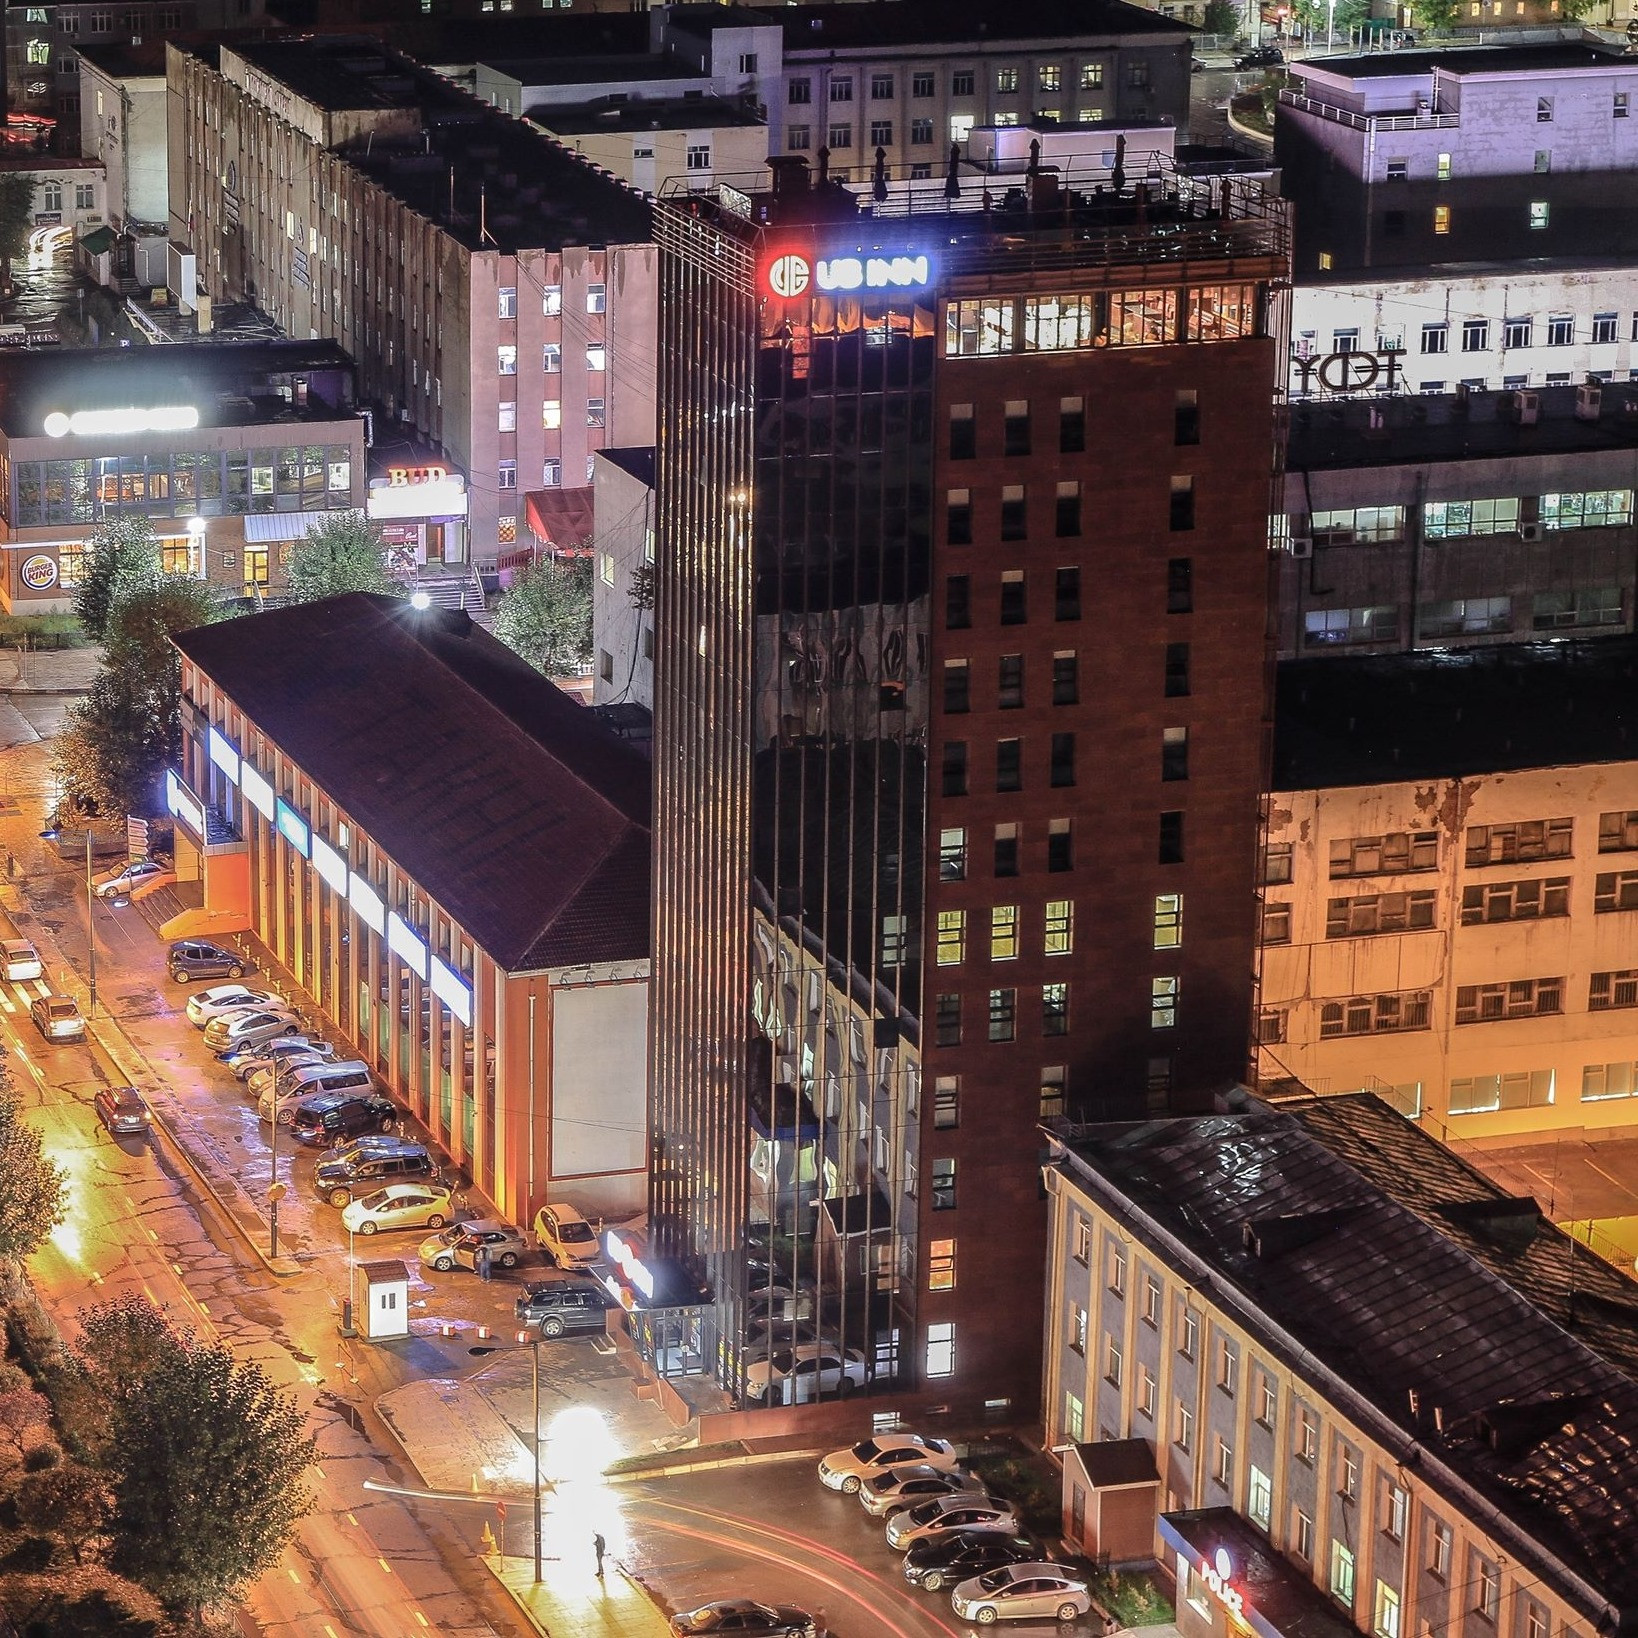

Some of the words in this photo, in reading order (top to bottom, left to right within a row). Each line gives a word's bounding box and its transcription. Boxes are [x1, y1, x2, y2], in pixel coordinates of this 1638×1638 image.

[866, 255, 928, 287] INN
[388, 467, 446, 488] BUD
[28, 562, 53, 574] BURGER
[28, 568, 53, 581] KING
[1201, 1561, 1244, 1617] POLICE
